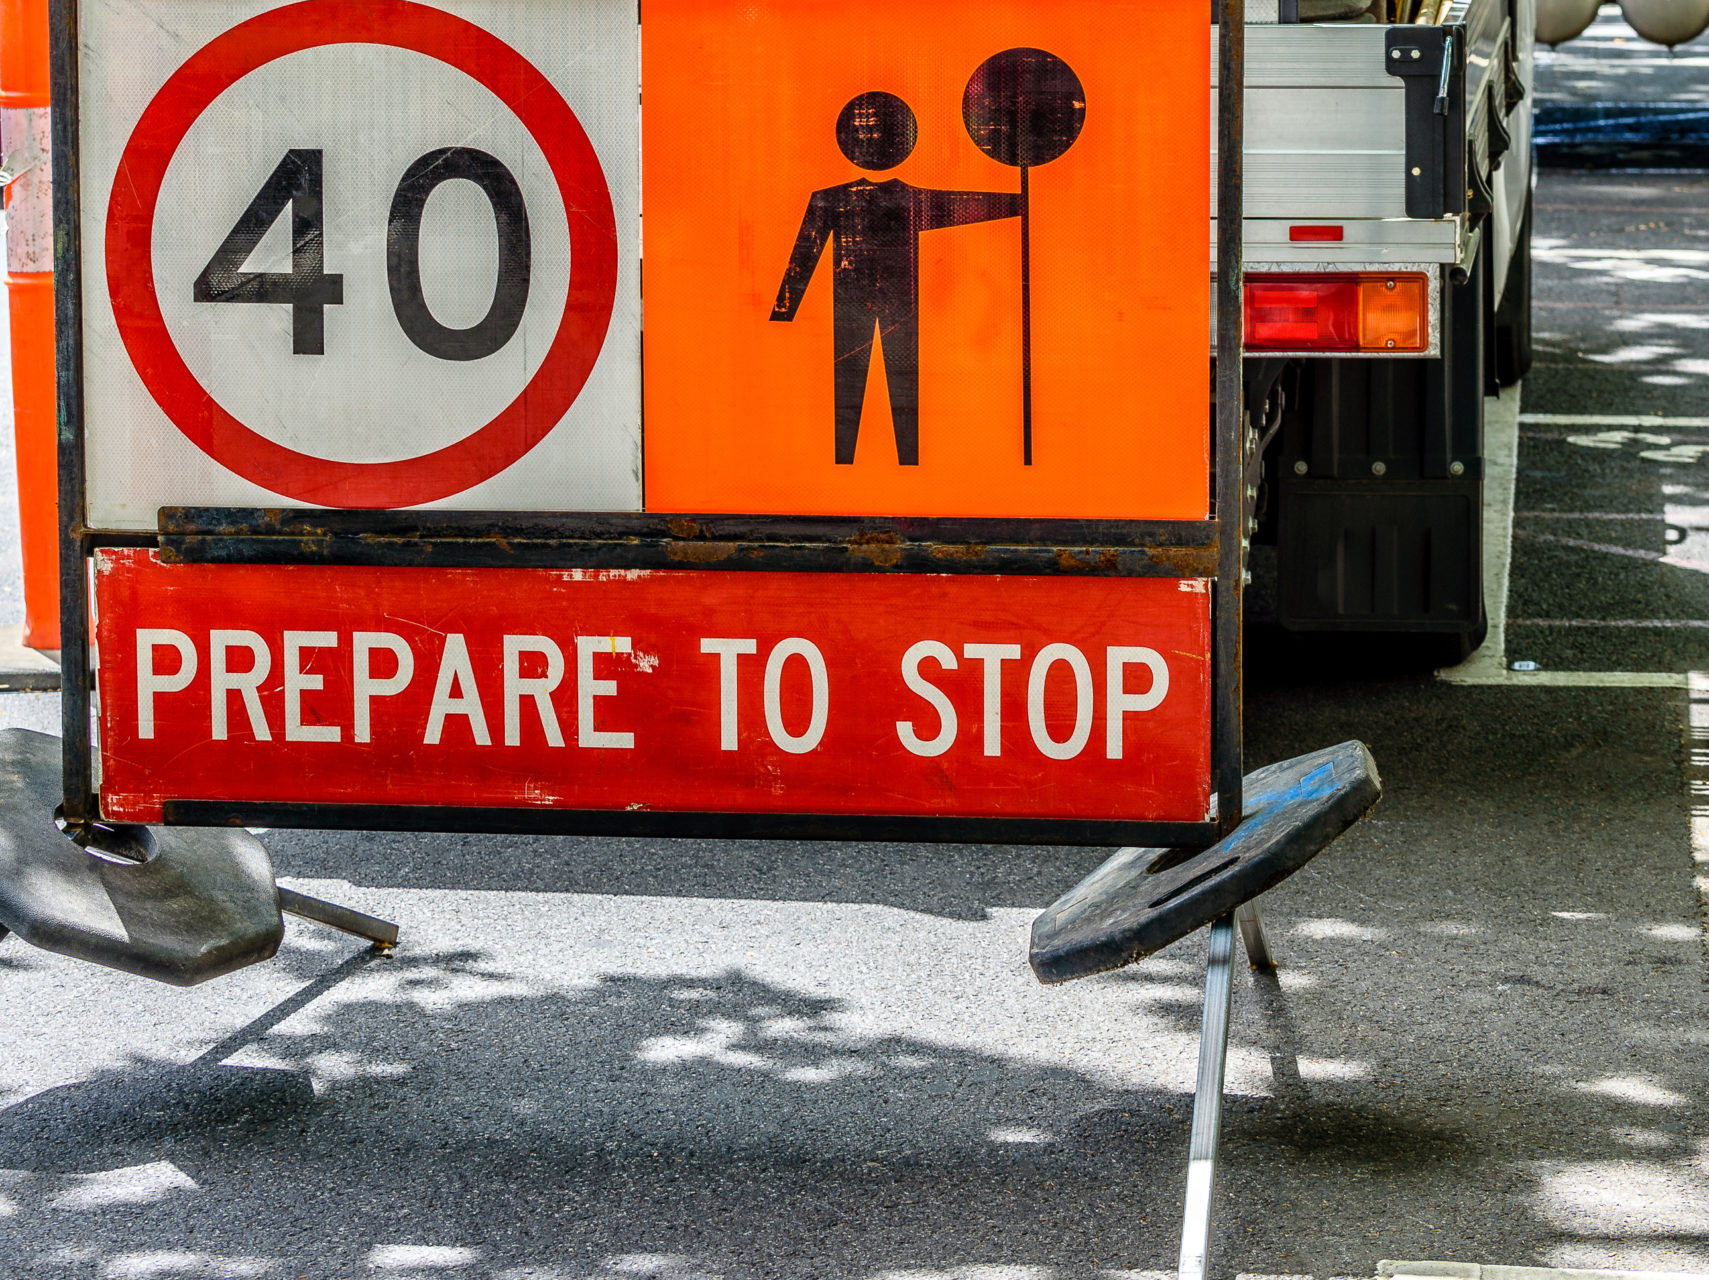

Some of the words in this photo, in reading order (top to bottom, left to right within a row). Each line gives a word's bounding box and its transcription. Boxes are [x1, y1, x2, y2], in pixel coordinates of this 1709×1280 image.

[193, 146, 531, 362] 40
[136, 628, 635, 749] PREPARE
[700, 637, 829, 754] TO
[896, 640, 1170, 760] STOP
